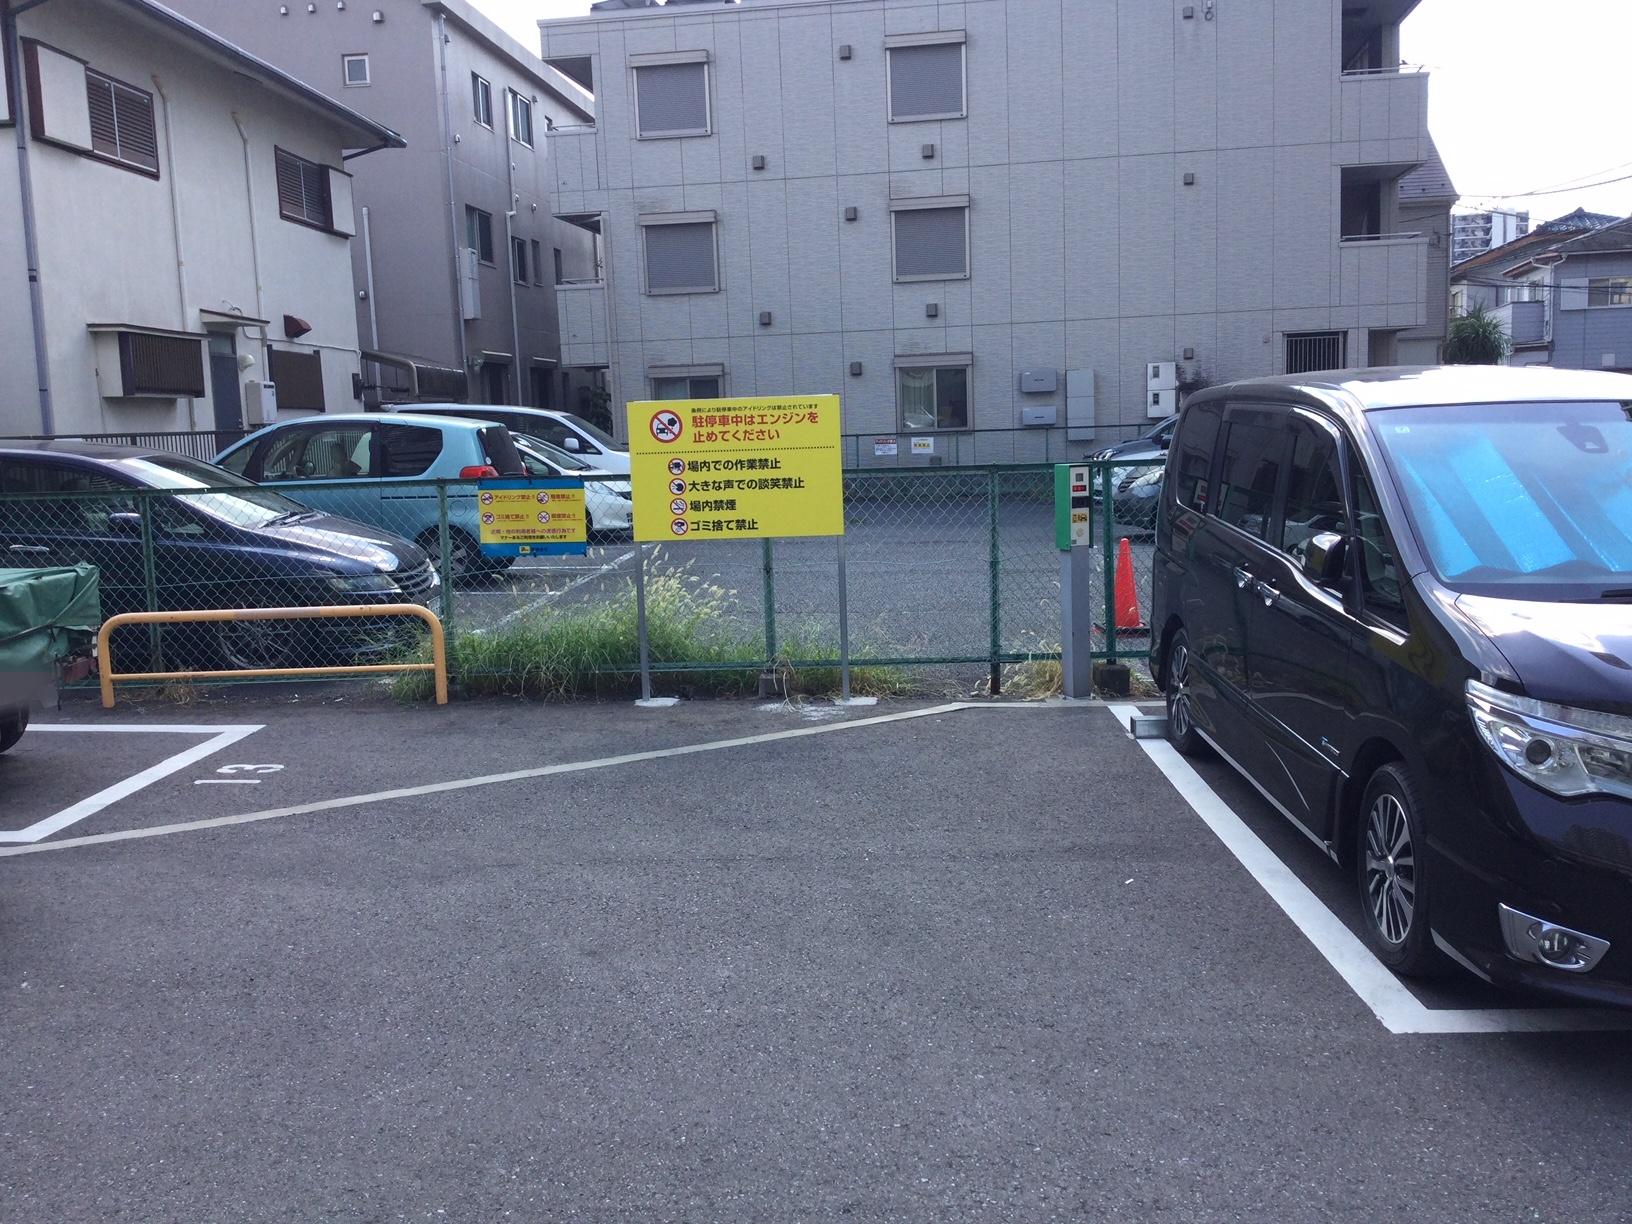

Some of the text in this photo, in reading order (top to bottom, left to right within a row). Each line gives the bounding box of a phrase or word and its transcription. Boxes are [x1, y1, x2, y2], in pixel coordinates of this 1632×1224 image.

[691, 411, 819, 428] 駐停車中はエンジンを
[692, 429, 780, 443] 止めてください
[687, 458, 781, 472] 場内での作業禁止
[688, 477, 805, 492] 大きな声での談笑禁止
[689, 499, 737, 512] 場内禁煙
[690, 519, 759, 532] ゴミ捨て禁止
[194, 764, 285, 785] 13
